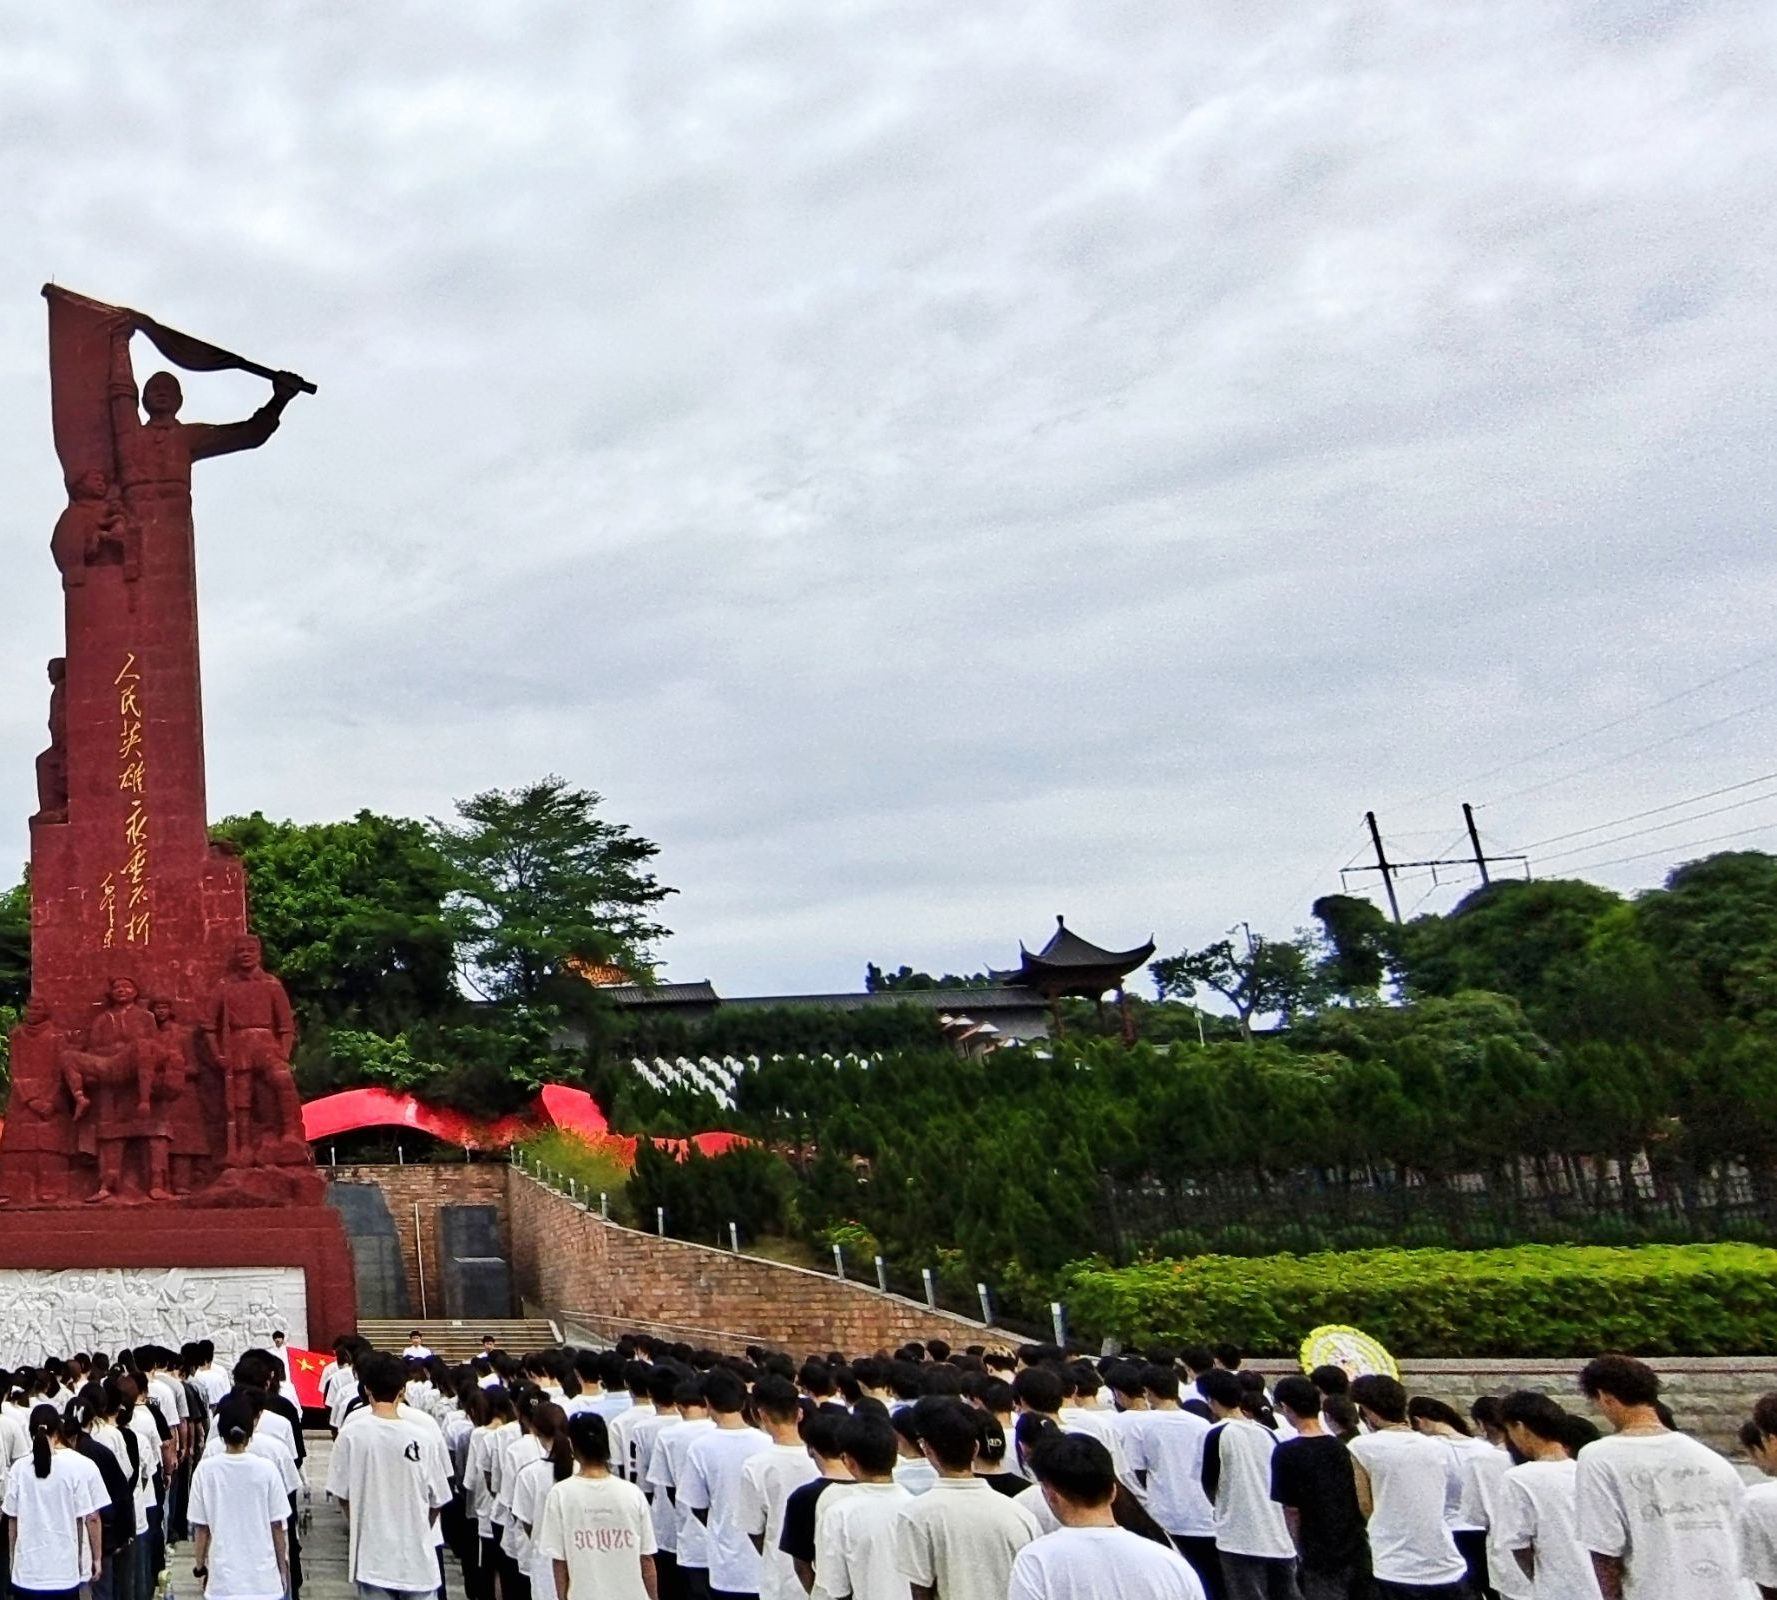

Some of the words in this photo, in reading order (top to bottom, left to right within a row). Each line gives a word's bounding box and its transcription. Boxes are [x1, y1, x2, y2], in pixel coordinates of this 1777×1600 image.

[114, 652, 150, 946] 人民英雄永垂不朽
